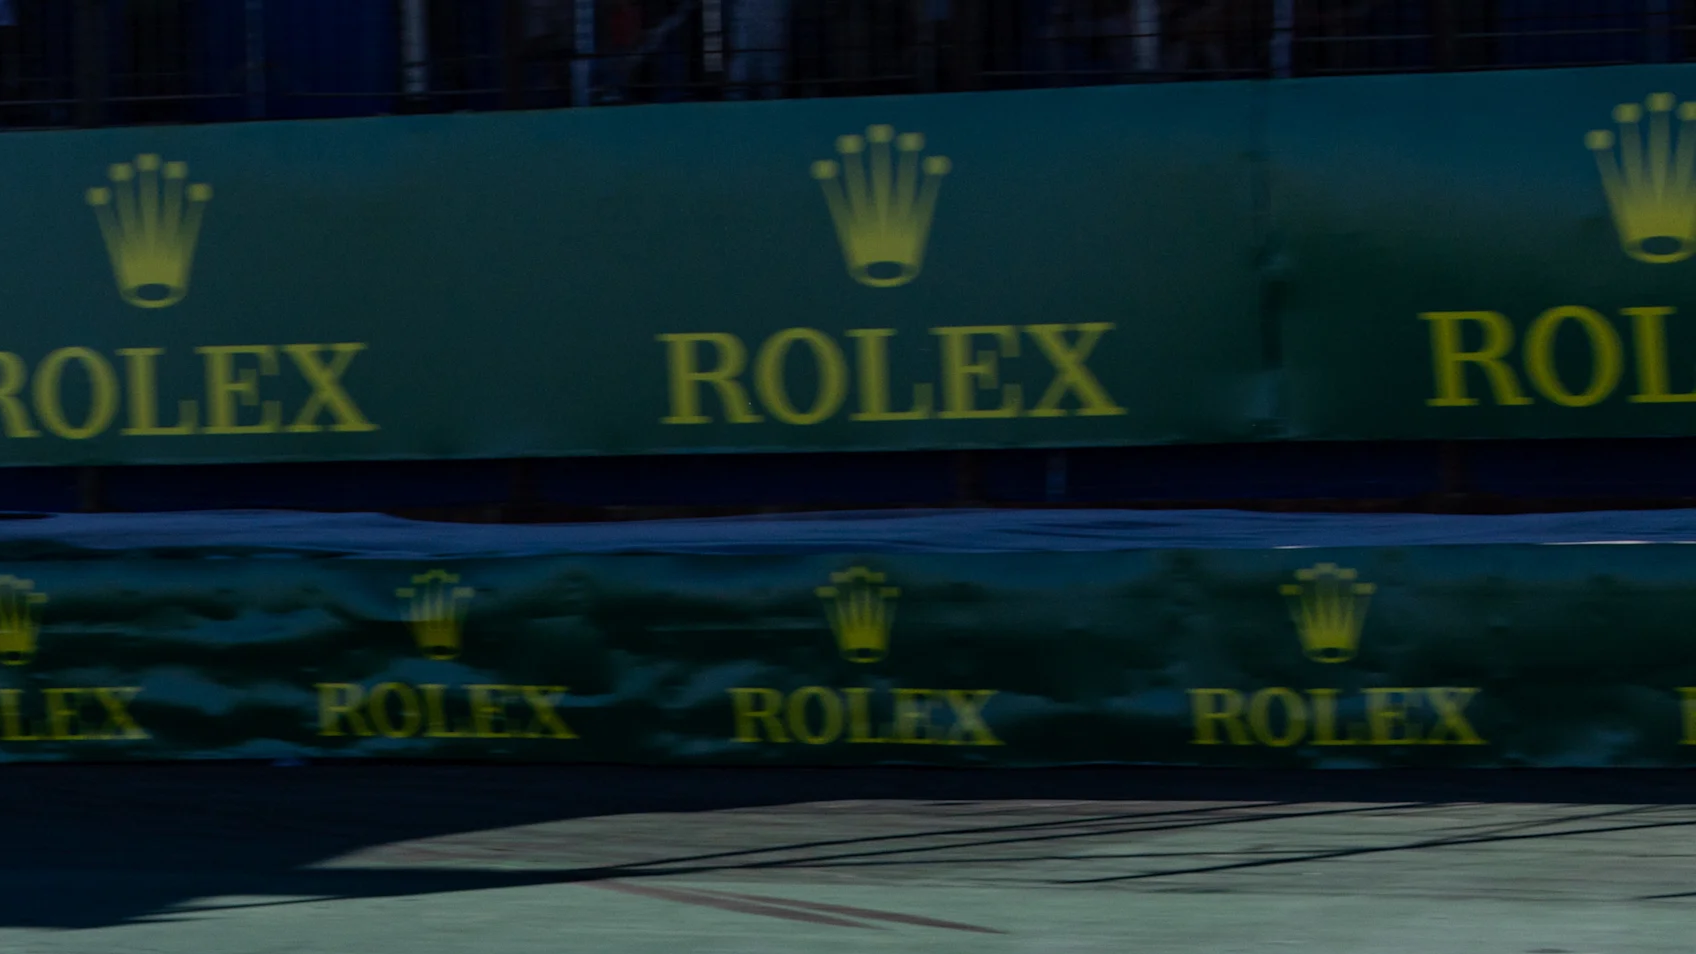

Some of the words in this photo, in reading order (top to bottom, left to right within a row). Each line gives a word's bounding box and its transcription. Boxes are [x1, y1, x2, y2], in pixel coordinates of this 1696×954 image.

[664, 323, 1122, 424] ROLEX
[318, 683, 577, 739] ROLEX
[733, 687, 1000, 745] ROLEX
[1194, 687, 1484, 746] ROLEX
